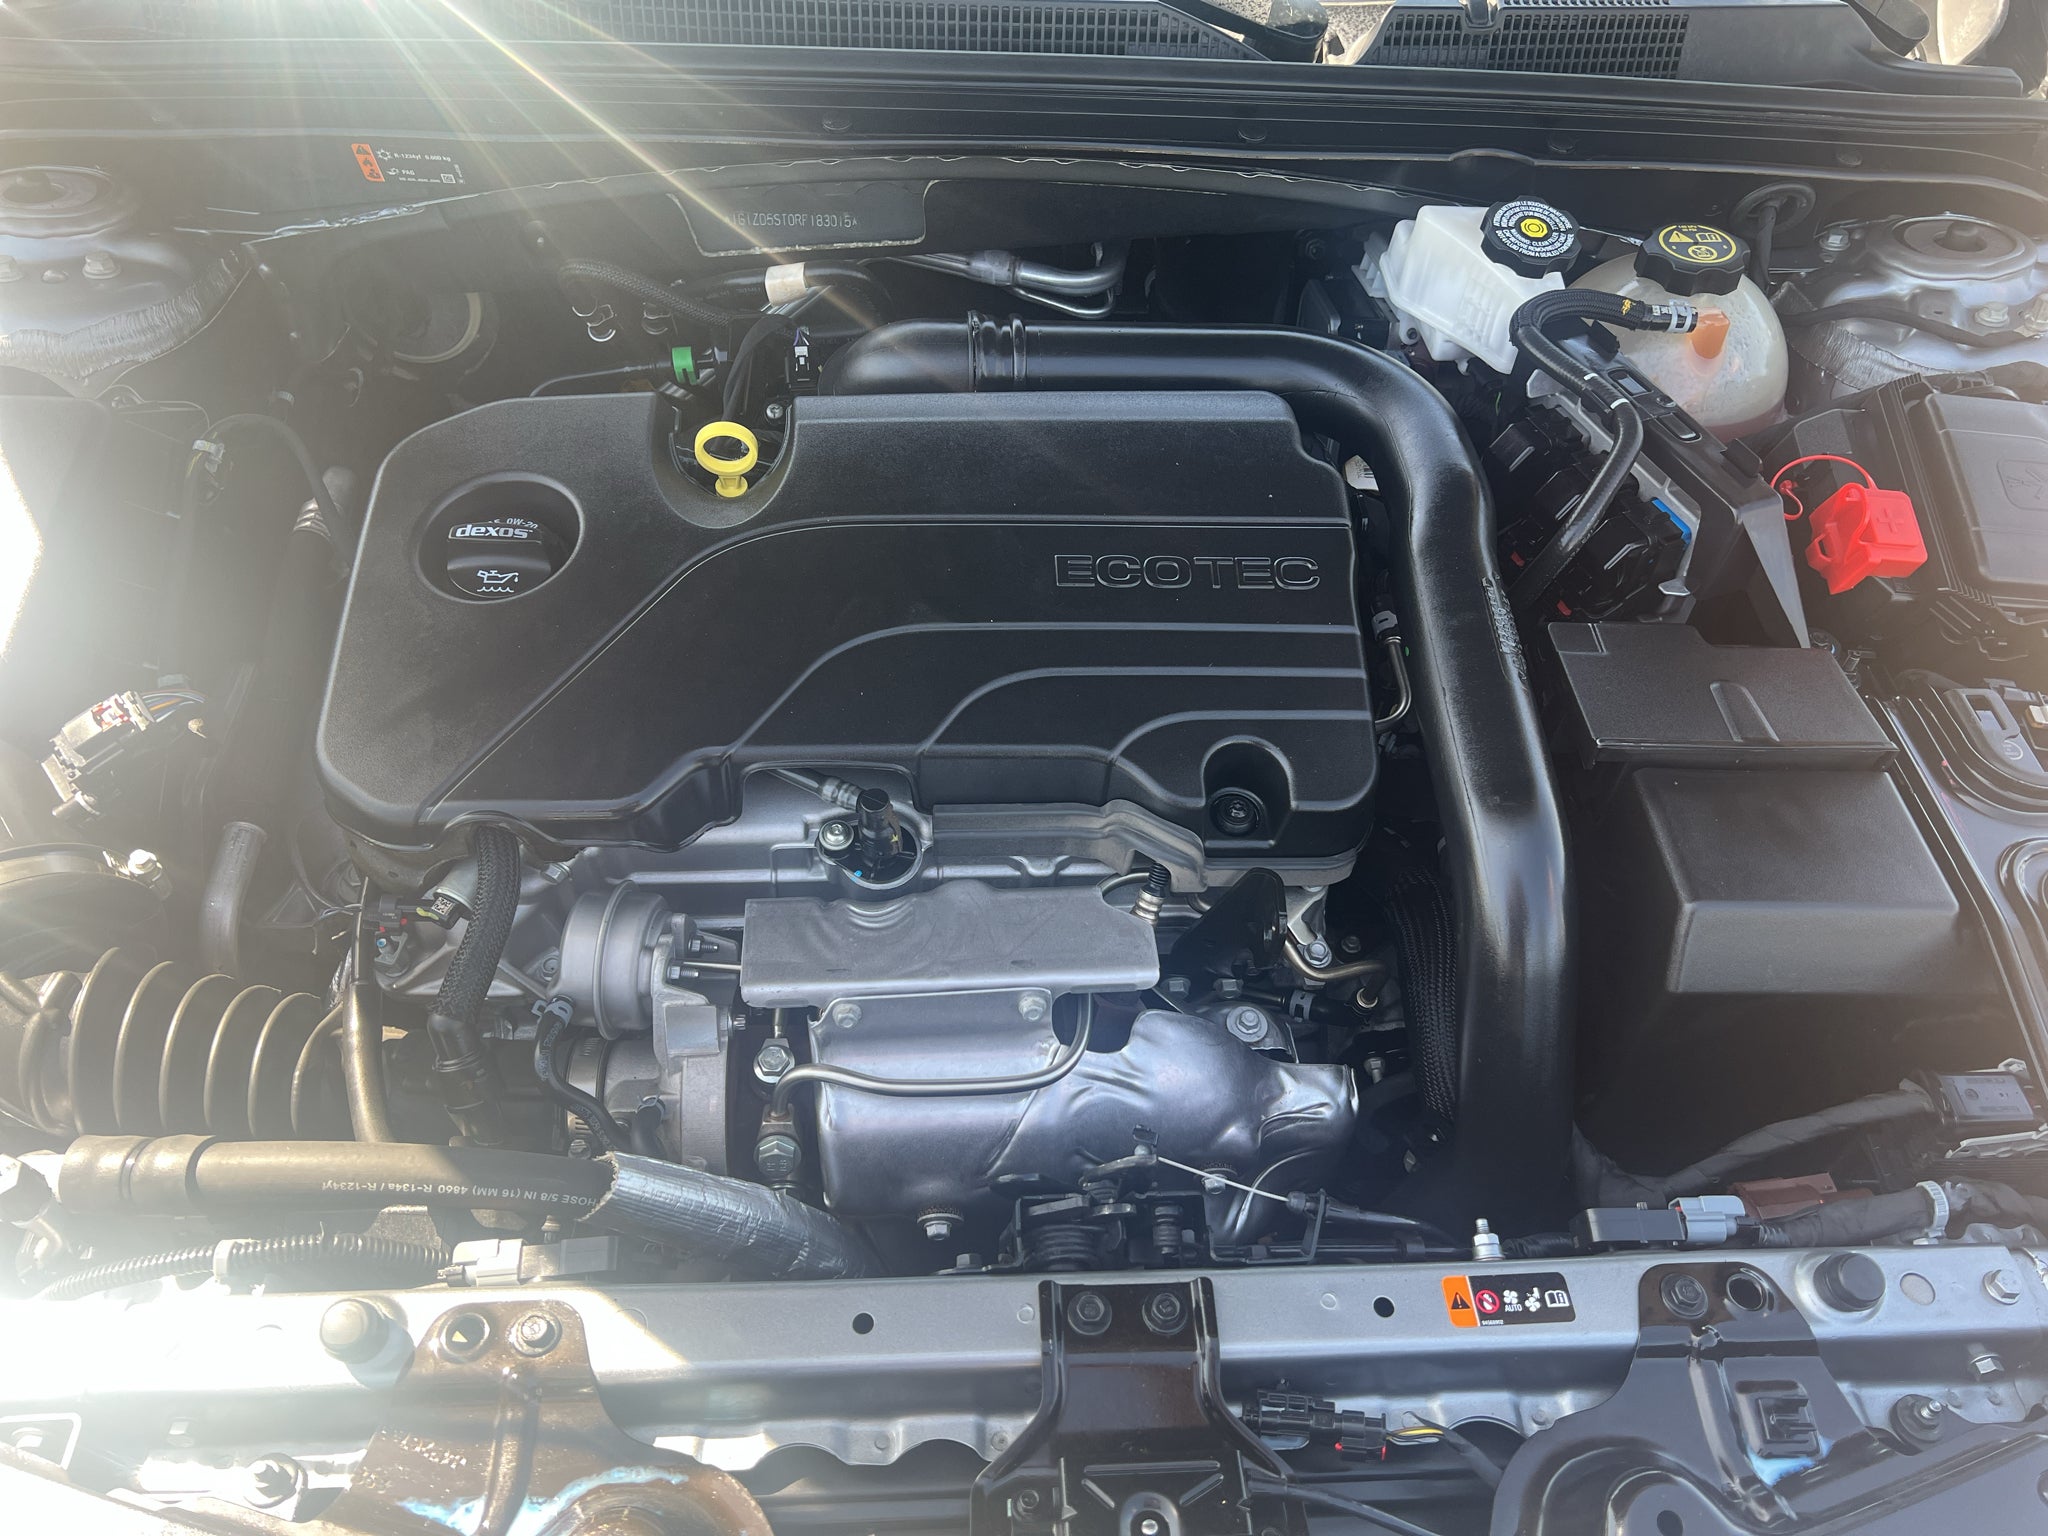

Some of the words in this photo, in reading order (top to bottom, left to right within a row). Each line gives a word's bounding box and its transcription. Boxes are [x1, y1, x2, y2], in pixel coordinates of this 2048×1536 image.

[455, 523, 529, 540] dexos
[1054, 554, 1321, 591] ECOTEC
[388, 1183, 432, 1193] R-134a
[438, 1184, 469, 1195] 4860
[472, 1185, 499, 1197] MM)
[502, 1188, 521, 1199] (16
[524, 1190, 537, 1200] IN
[540, 1192, 559, 1202] 5/8
[561, 1194, 597, 1207] HOSE
[1504, 1304, 1523, 1312] AUTO
